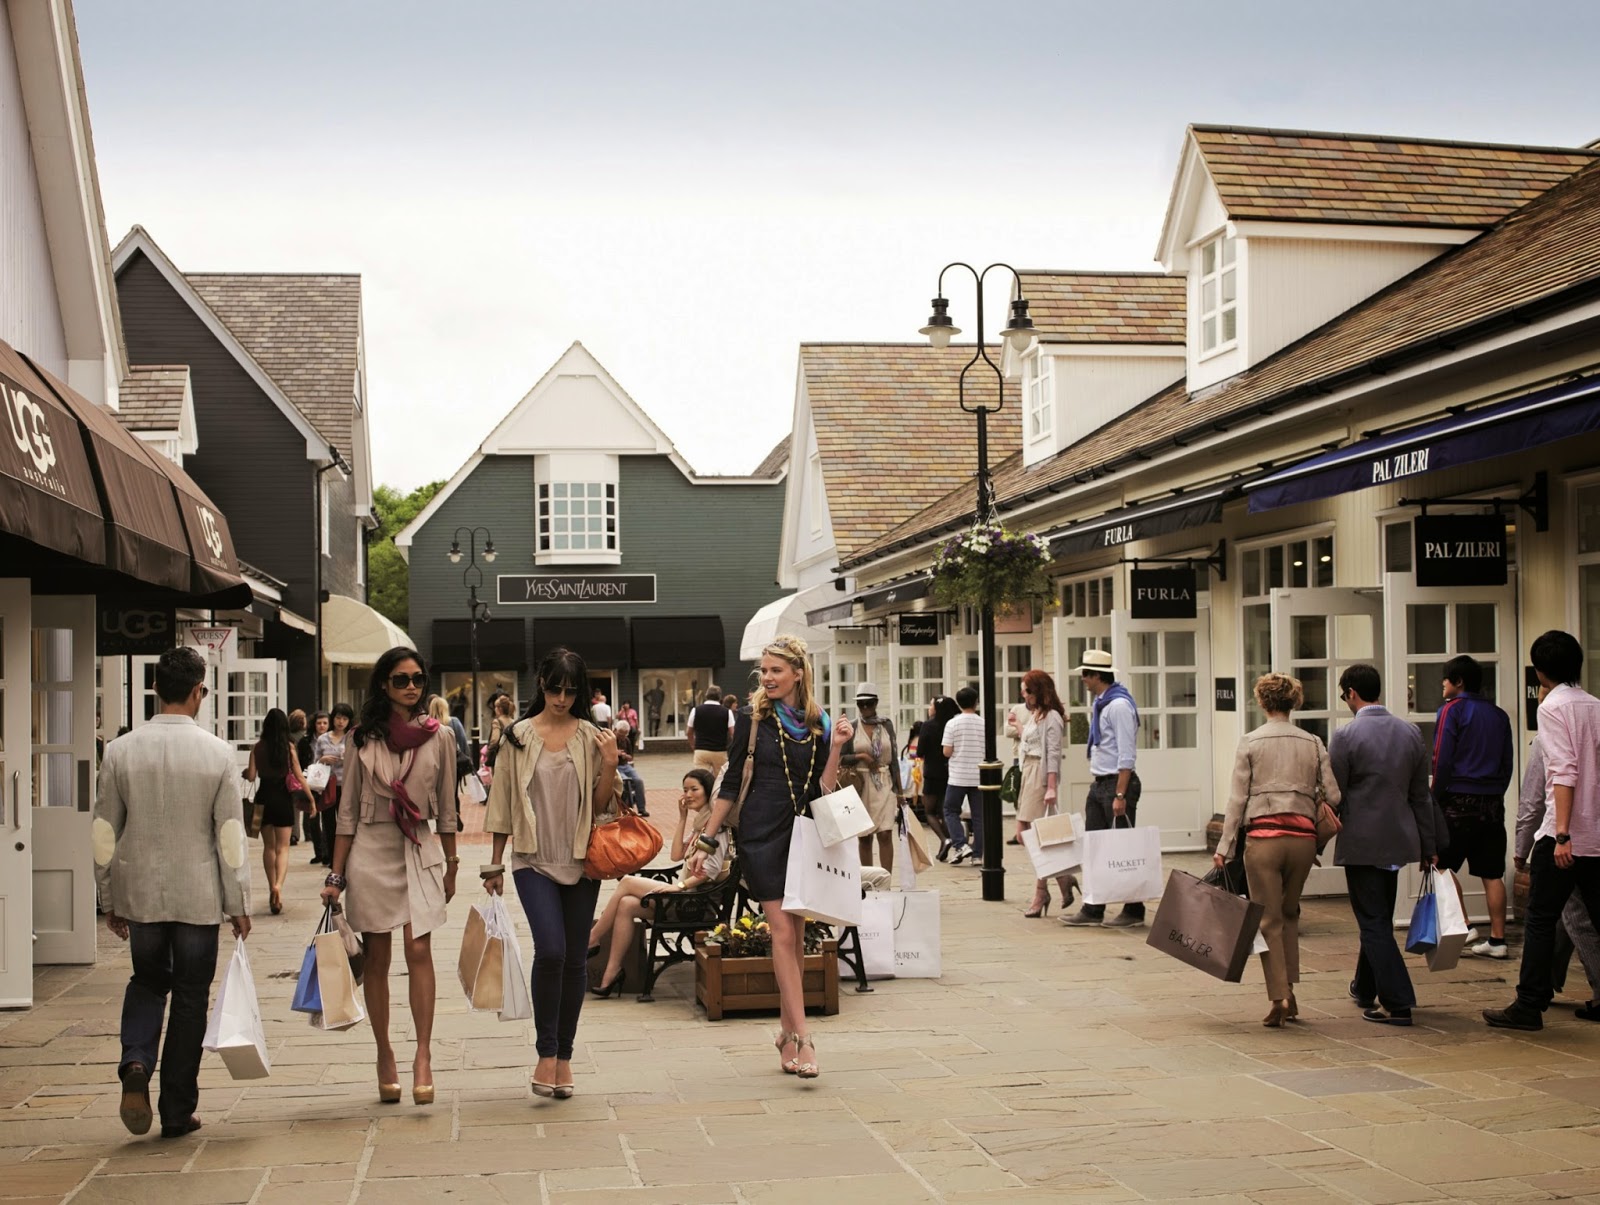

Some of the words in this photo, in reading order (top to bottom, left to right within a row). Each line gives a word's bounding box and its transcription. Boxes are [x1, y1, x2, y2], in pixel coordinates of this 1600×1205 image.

[1, 382, 56, 474] UGG
[1371, 459, 1392, 483] PAL
[1394, 448, 1429, 478] ZILERI
[23, 467, 66, 495] australia
[196, 505, 223, 558] UGG
[1104, 524, 1132, 546] FURLA
[1425, 542, 1453, 558] PAL
[1455, 541, 1500, 557] ZILERI
[1137, 588, 1190, 600] FURLA
[102, 610, 168, 639] UGG
[901, 624, 936, 637] Temperley
[196, 632, 224, 640] GUESS
[1216, 689, 1234, 699] FURLA
[817, 862, 850, 880] MARNI
[1108, 858, 1145, 868] HACKETT
[1168, 929, 1212, 957] BASLER
[894, 951, 920, 960] AURENT
